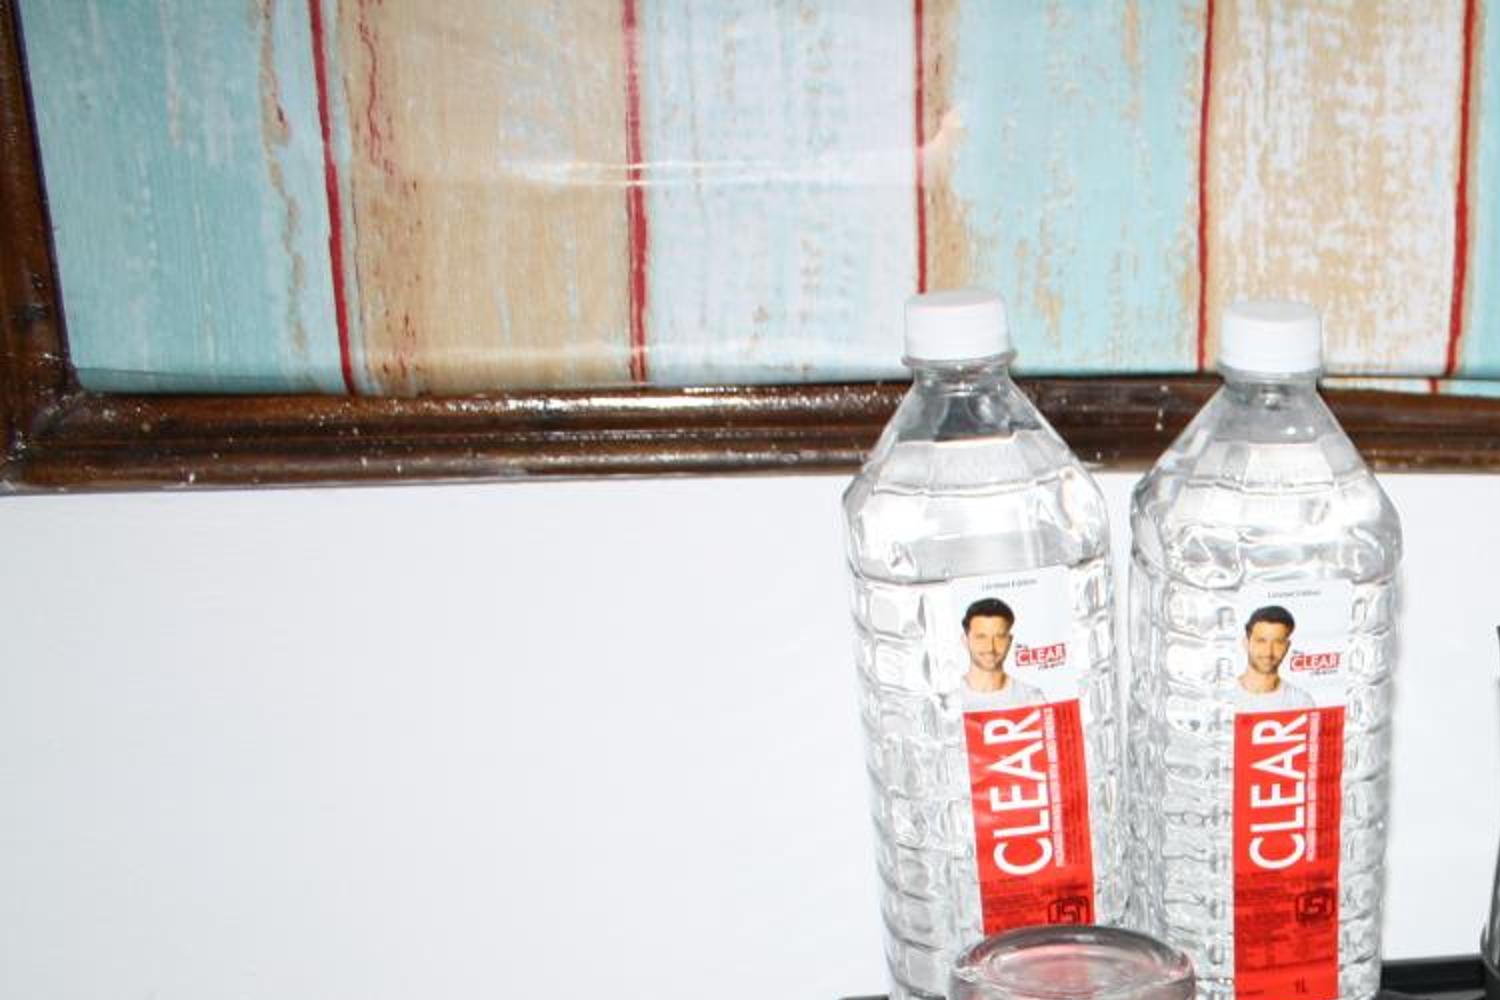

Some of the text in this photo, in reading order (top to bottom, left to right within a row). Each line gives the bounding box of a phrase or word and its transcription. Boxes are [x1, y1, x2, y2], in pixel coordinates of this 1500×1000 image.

[1017, 644, 1065, 667] CLEAR
[1291, 653, 1340, 671] CLEAR
[983, 708, 1053, 876] CLEAR
[1249, 714, 1308, 870] CLEAR
